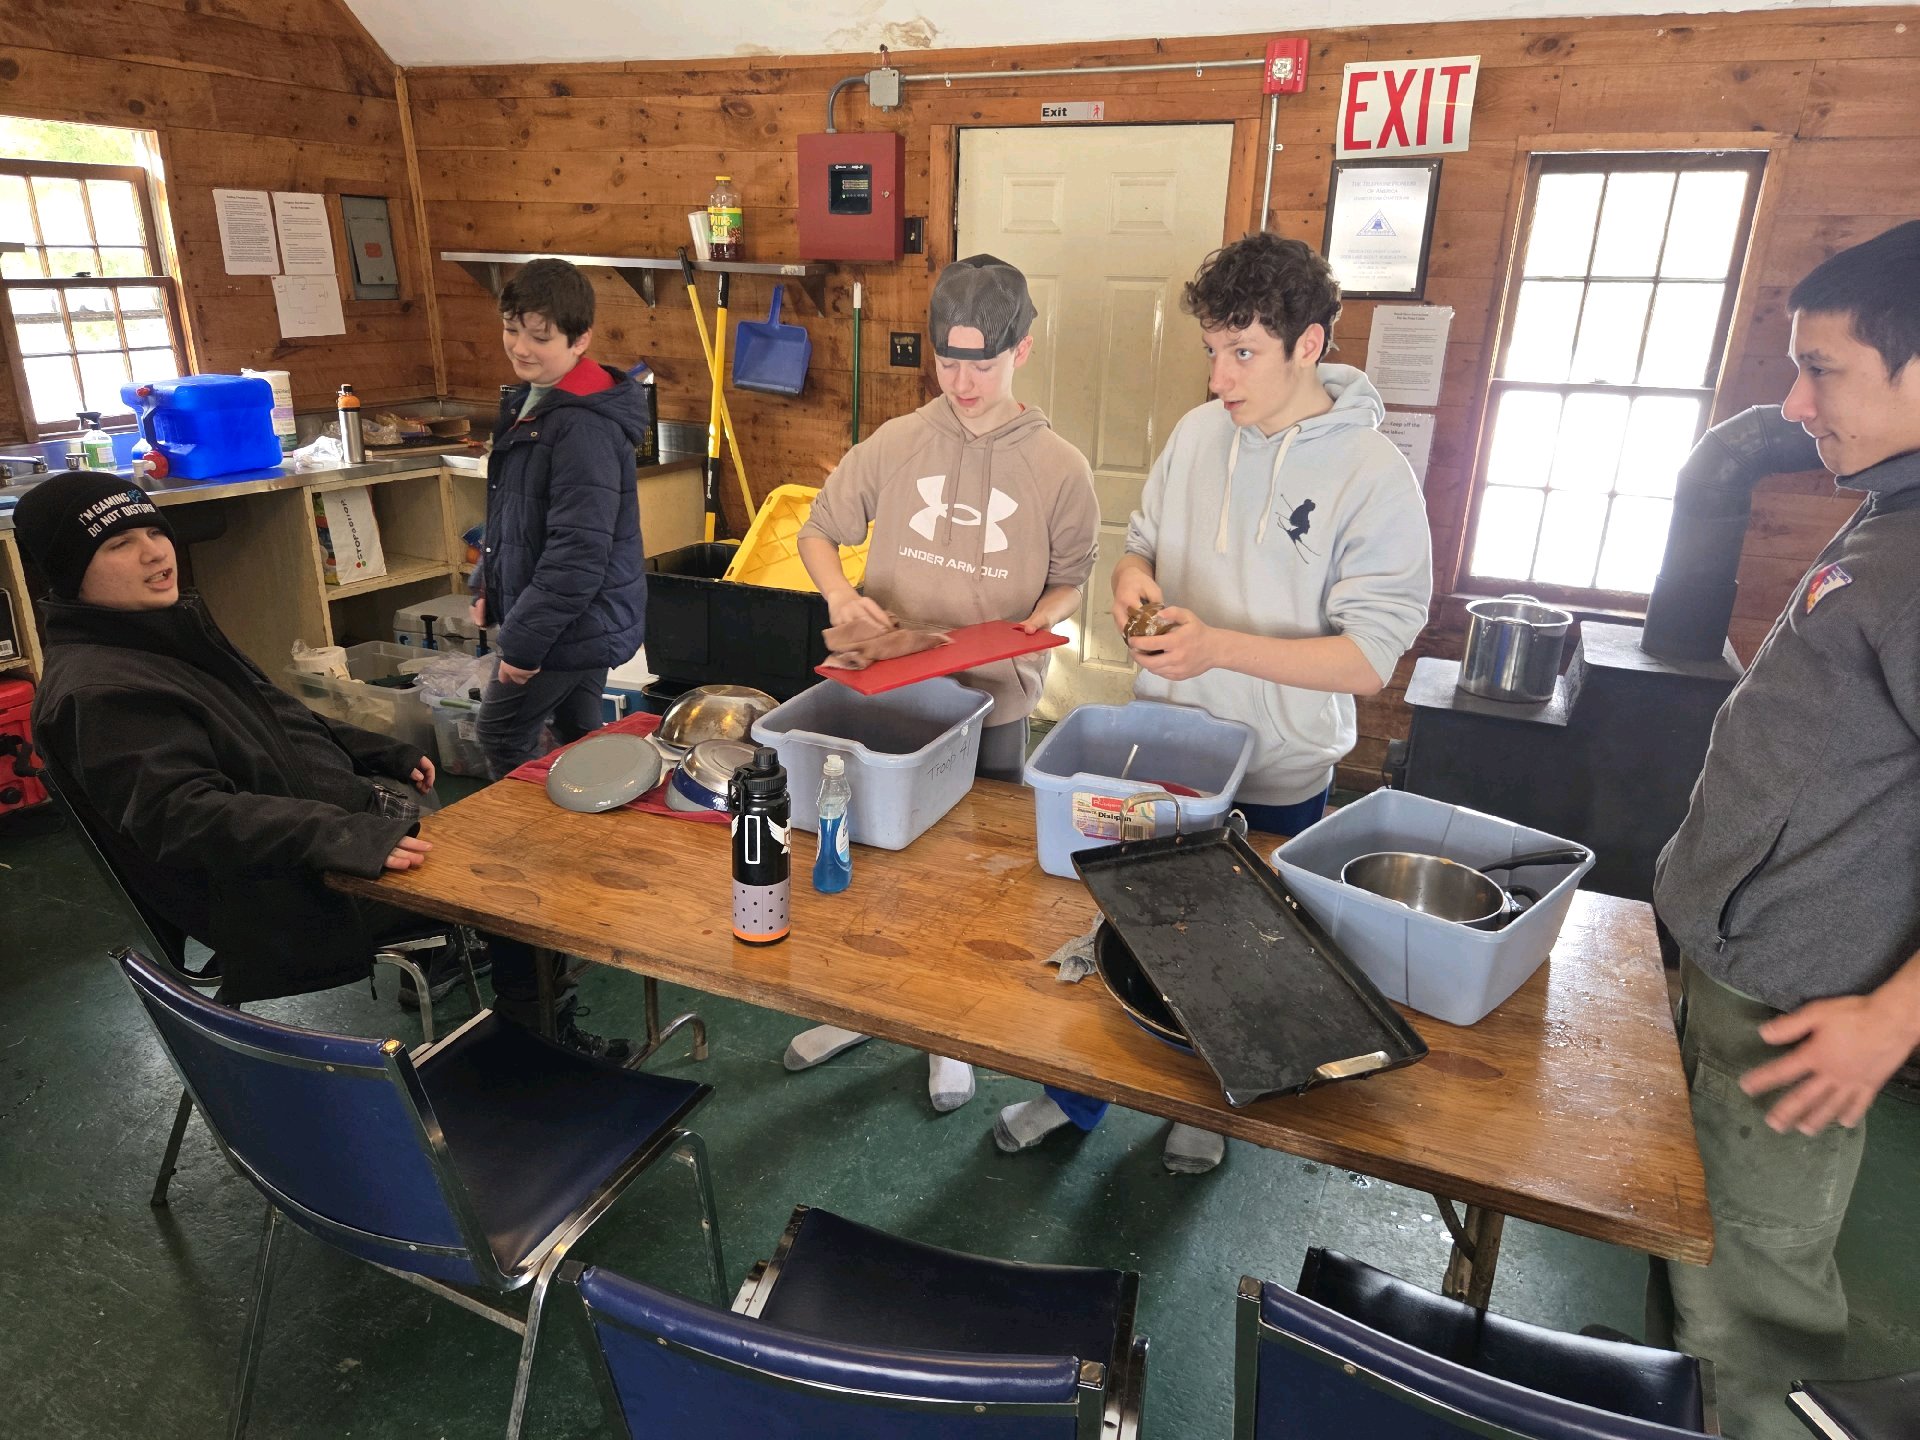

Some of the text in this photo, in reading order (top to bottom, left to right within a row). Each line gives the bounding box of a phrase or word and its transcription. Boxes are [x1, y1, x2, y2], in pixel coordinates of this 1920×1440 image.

[1042, 106, 1068, 117] Exit
[1343, 65, 1472, 151] EXIT
[712, 226, 728, 237] Sol
[78, 492, 131, 526] I'M GAMING
[87, 503, 156, 538] DO NOT DISTURB
[899, 544, 945, 566] UNDER
[927, 753, 957, 781] Troop
